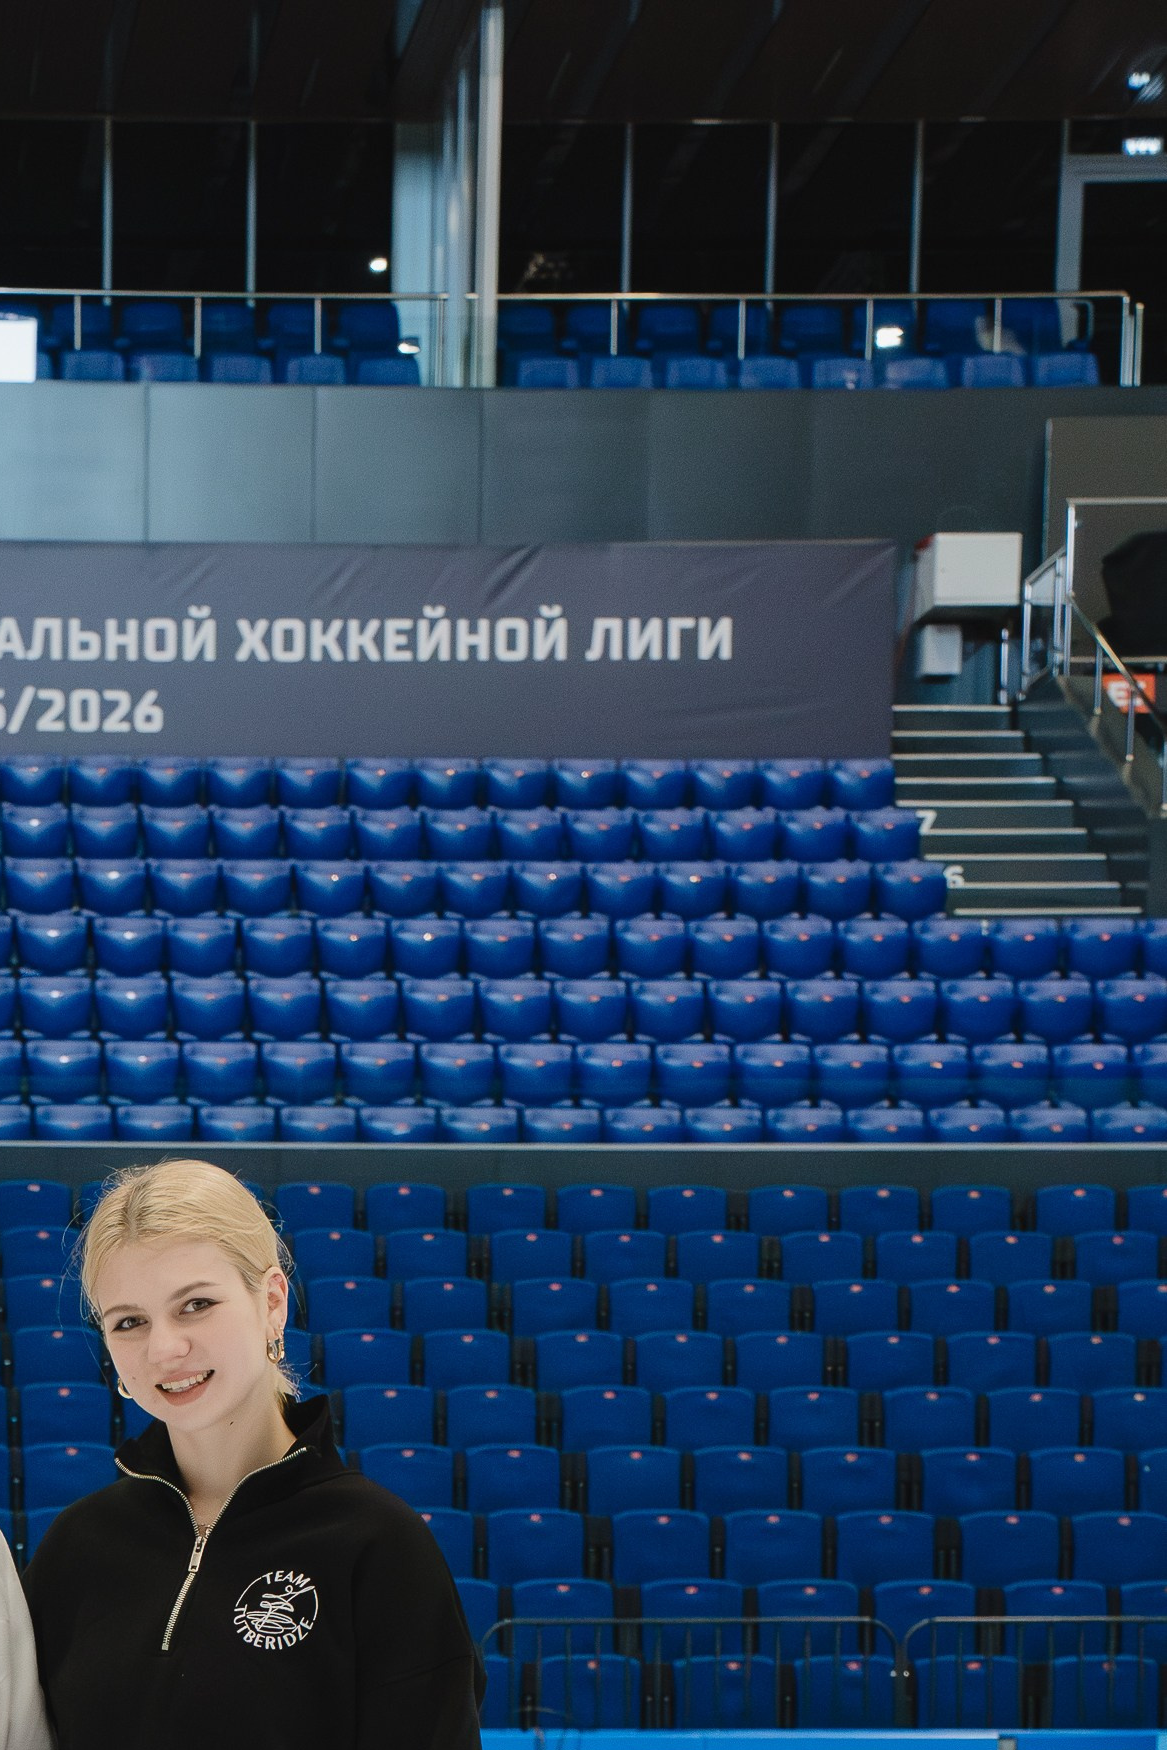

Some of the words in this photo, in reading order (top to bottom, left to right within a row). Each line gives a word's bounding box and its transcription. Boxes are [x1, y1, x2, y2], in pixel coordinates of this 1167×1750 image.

[236, 605, 569, 664] ХОККЕЙНОЙ
[585, 616, 734, 662] ЛИГИ
[263, 1570, 311, 1588] TEAM
[234, 1604, 314, 1650] TUTBERIDZE
